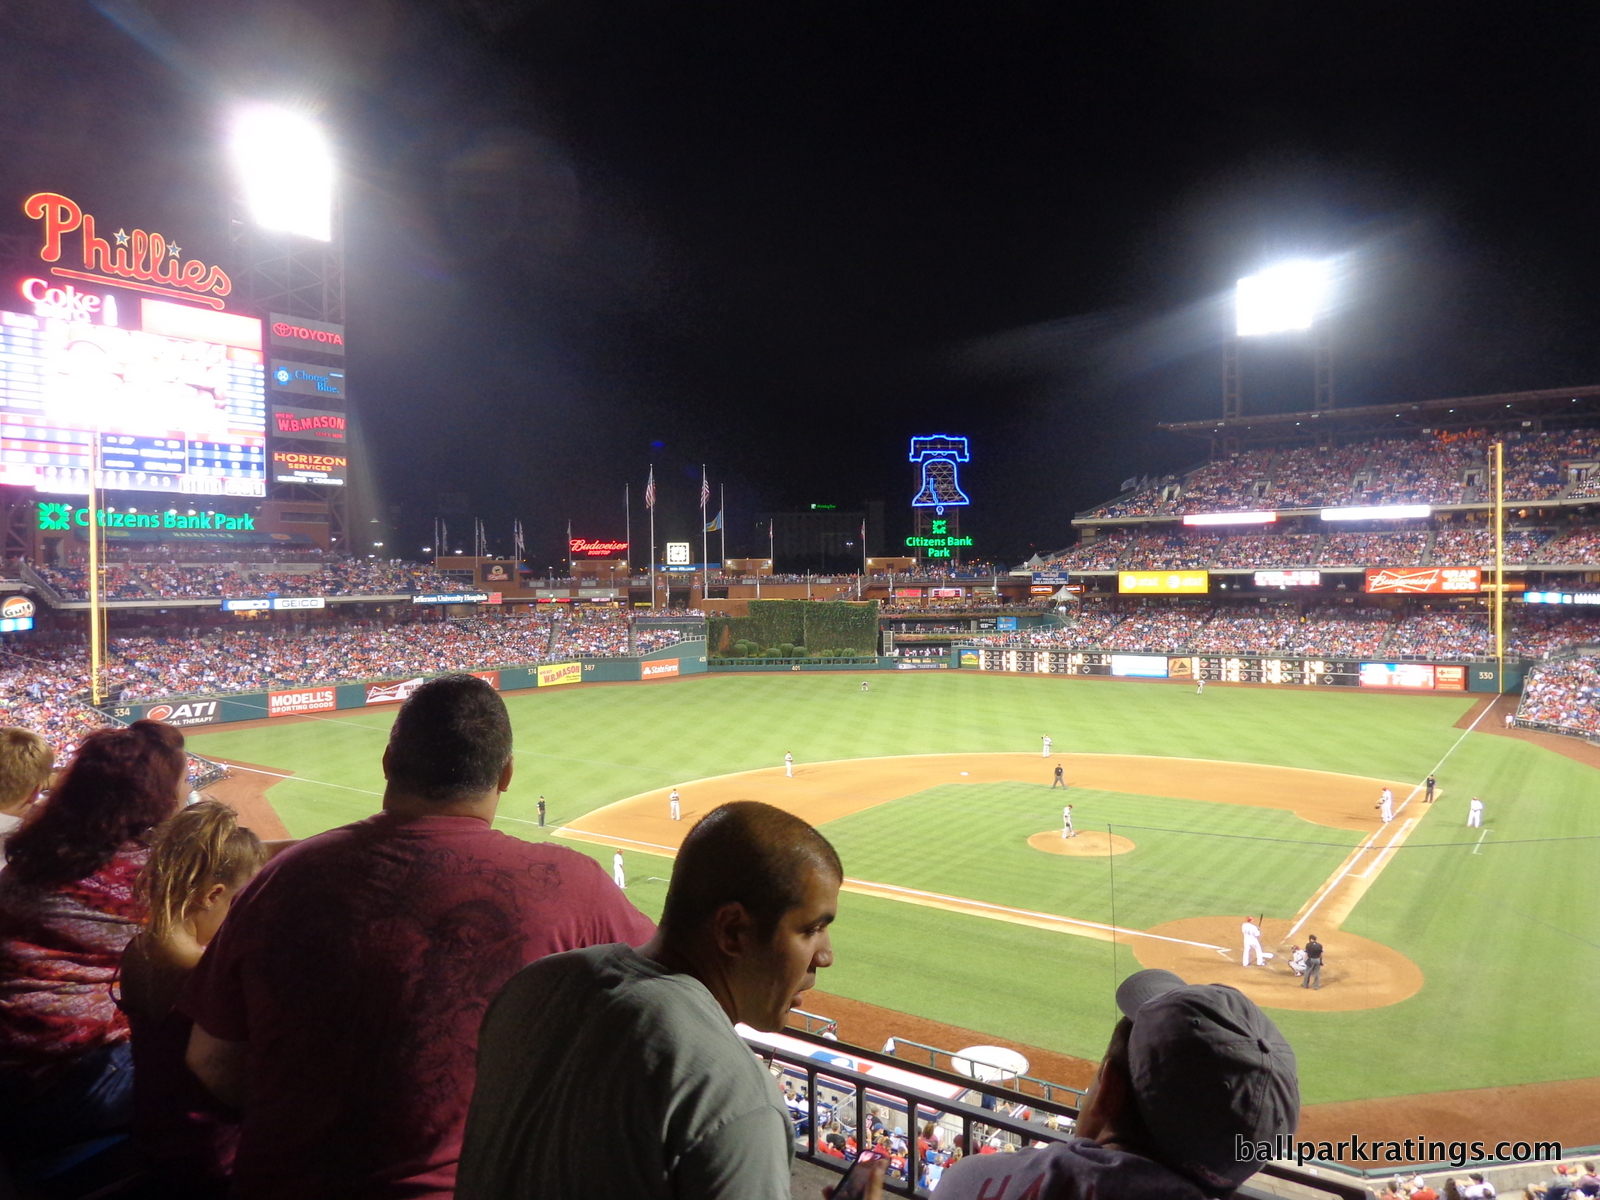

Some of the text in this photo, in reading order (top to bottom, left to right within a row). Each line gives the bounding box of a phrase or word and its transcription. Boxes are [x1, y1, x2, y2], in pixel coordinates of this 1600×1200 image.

[25, 192, 232, 296] Phillies
[21, 278, 101, 312] Coke
[291, 326, 343, 345] TOYOTA
[294, 369, 329, 383] Choose
[274, 452, 347, 467] HORIZON
[288, 463, 333, 471] SERVICES
[75, 508, 256, 530] Ctizens Bank Park
[570, 539, 628, 551] Budweiser
[906, 536, 973, 546] Citizens Bank
[928, 547, 950, 557] Park
[1368, 575, 1437, 587] Budweiser
[413, 591, 437, 603] Jefferson
[437, 590, 463, 602] University
[464, 588, 488, 602] Hospitals
[281, 600, 318, 608] GEICO
[5, 604, 31, 617] Gulf
[1478, 672, 1493, 680] 330
[271, 691, 333, 707] MODELL'S
[114, 708, 130, 717] 334
[170, 701, 217, 719] ATI
[272, 704, 308, 713] SPORTING
[183, 716, 213, 725] THERAPY
